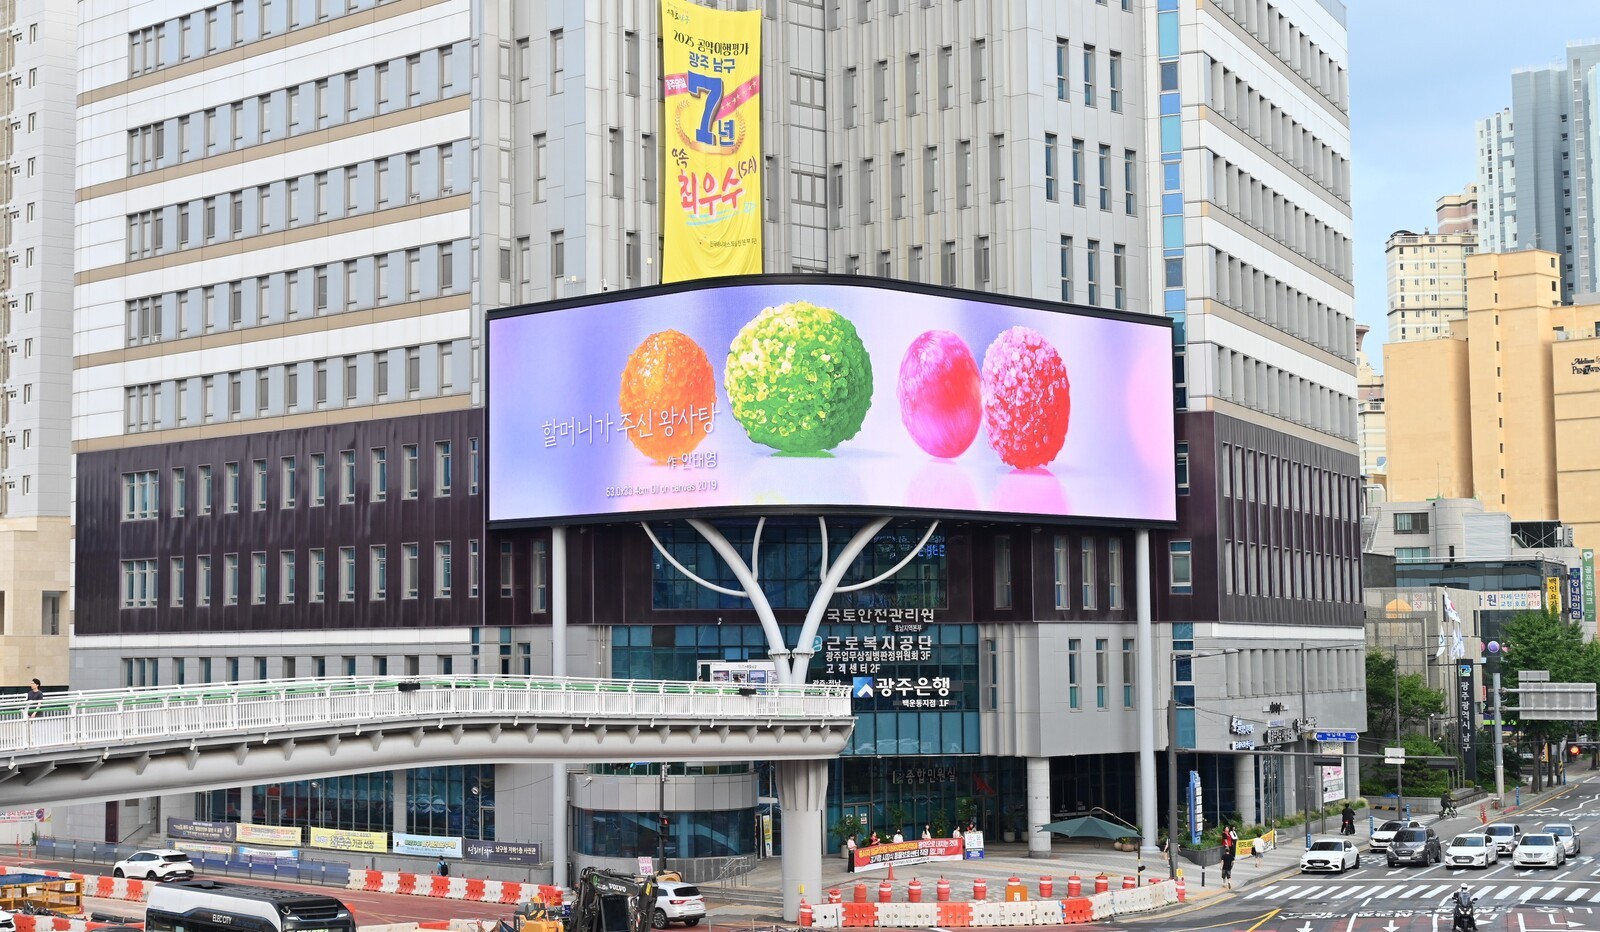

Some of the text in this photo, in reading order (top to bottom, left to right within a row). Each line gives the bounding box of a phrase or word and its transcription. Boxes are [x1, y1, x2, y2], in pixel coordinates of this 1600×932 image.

[673, 30, 749, 57] 2025 공약이행평가
[689, 51, 736, 74] 광주 남구
[678, 167, 743, 216] 최우수
[541, 402, 721, 448] 할머니가 주신 왕사탕
[681, 451, 717, 470] 안태영
[671, 483, 696, 493] canvas
[698, 480, 717, 492] 2019
[827, 608, 934, 623] 국토안전관리원
[894, 624, 923, 632] 호남지역본부
[826, 635, 933, 651] 근로복지공단
[825, 651, 931, 662] 광주업무상질병판정위원회 3F
[826, 663, 881, 674] 고객센터 2F
[875, 677, 951, 697] 광주은행
[902, 699, 949, 708] 백운동지점 1F
[1461, 681, 1471, 752] 광주광역시 남구
[905, 767, 956, 785] 종합민원실
[608, 882, 627, 893] VOLVO
[212, 913, 232, 925] ELEC CITY
